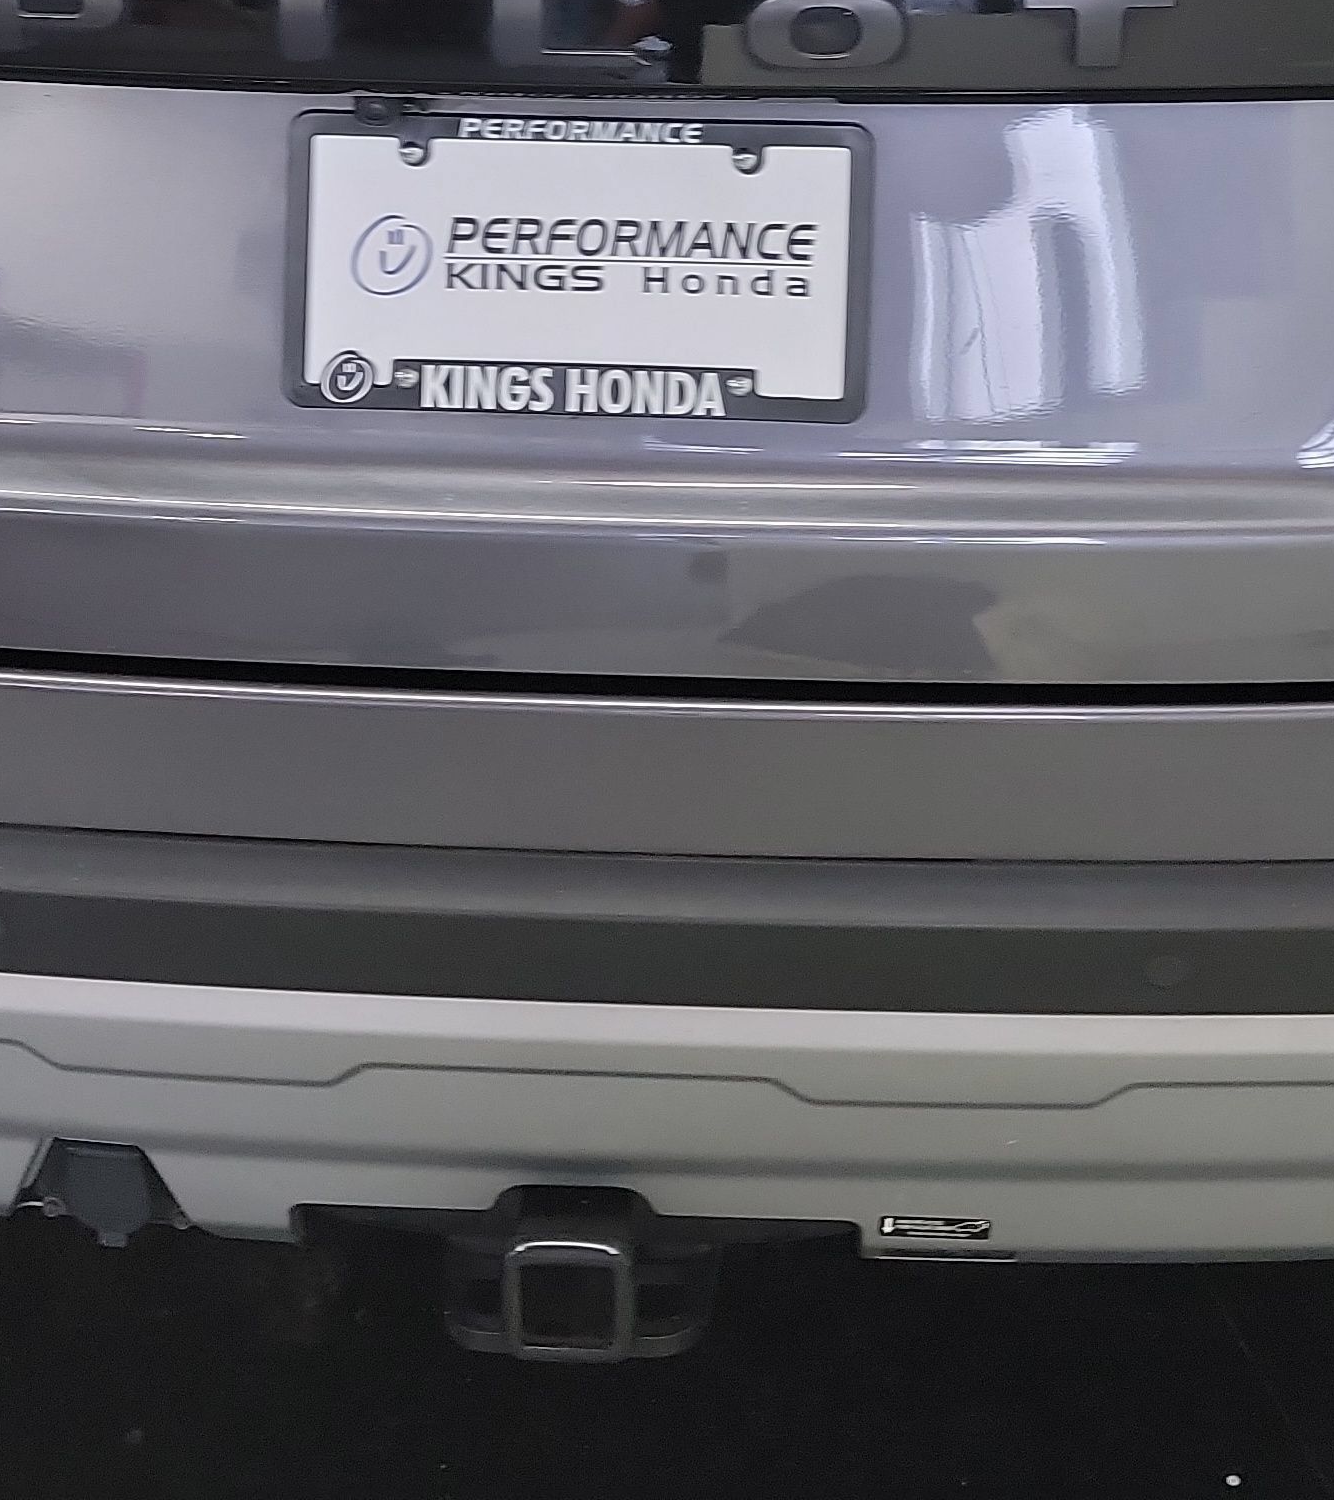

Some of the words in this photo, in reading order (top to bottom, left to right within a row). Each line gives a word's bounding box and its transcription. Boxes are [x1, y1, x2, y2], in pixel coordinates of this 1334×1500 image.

[458, 118, 703, 144] PERFORMANCE
[446, 216, 818, 262] PERFORMANCE
[445, 262, 605, 293] KINGS
[643, 266, 812, 297] Honda
[419, 364, 554, 412] KINGS
[564, 368, 727, 417] HONDA
